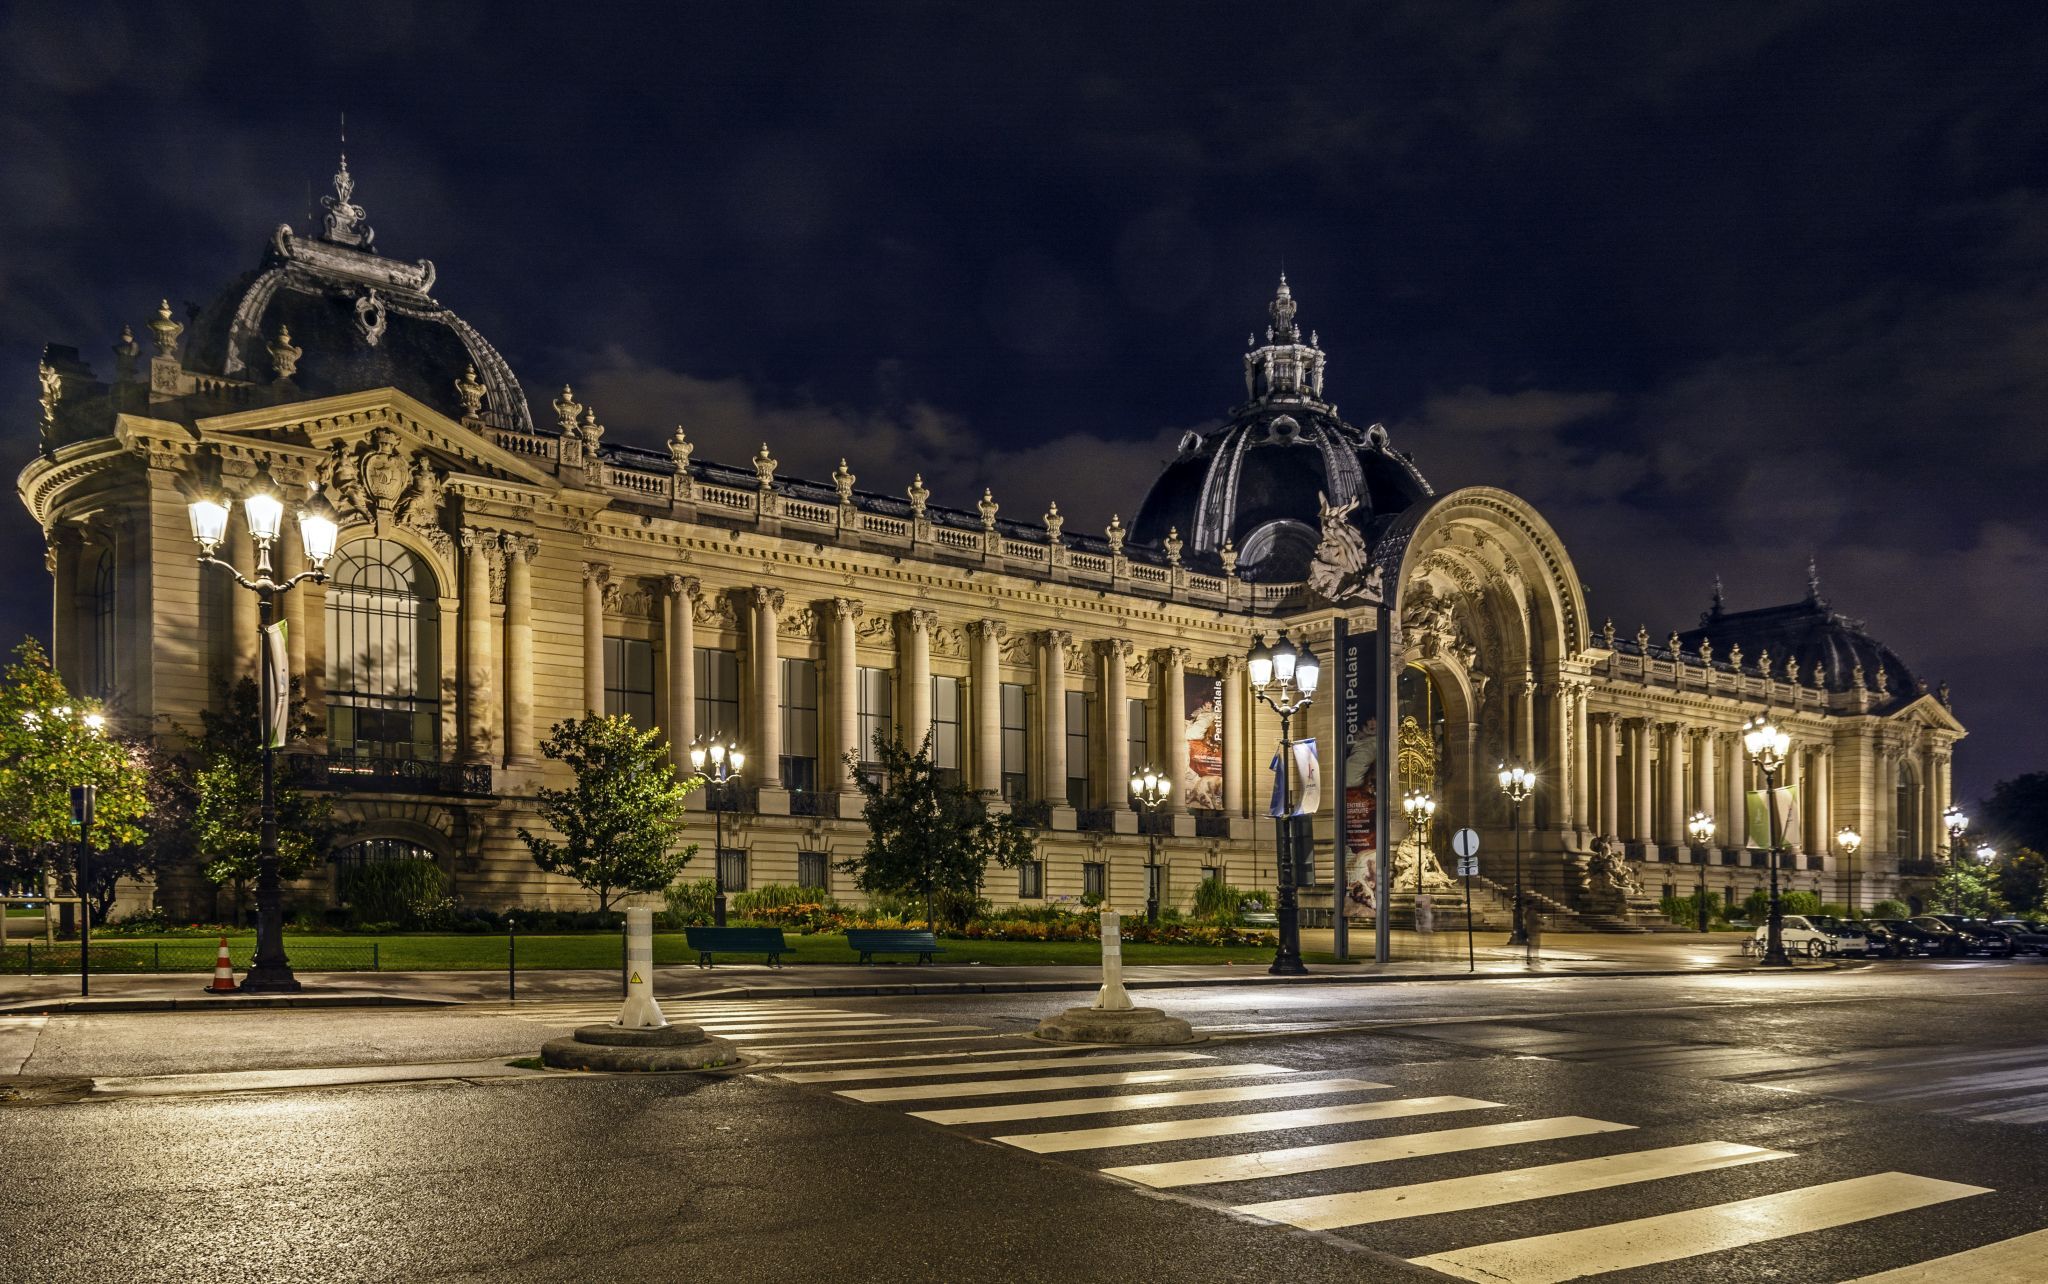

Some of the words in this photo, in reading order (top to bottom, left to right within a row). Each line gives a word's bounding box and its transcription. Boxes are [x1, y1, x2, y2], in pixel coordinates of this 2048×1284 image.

[1346, 646, 1358, 700] Palais
[1213, 680, 1222, 713] Palais
[1213, 714, 1222, 741] Petit
[1346, 703, 1359, 745] Petit
